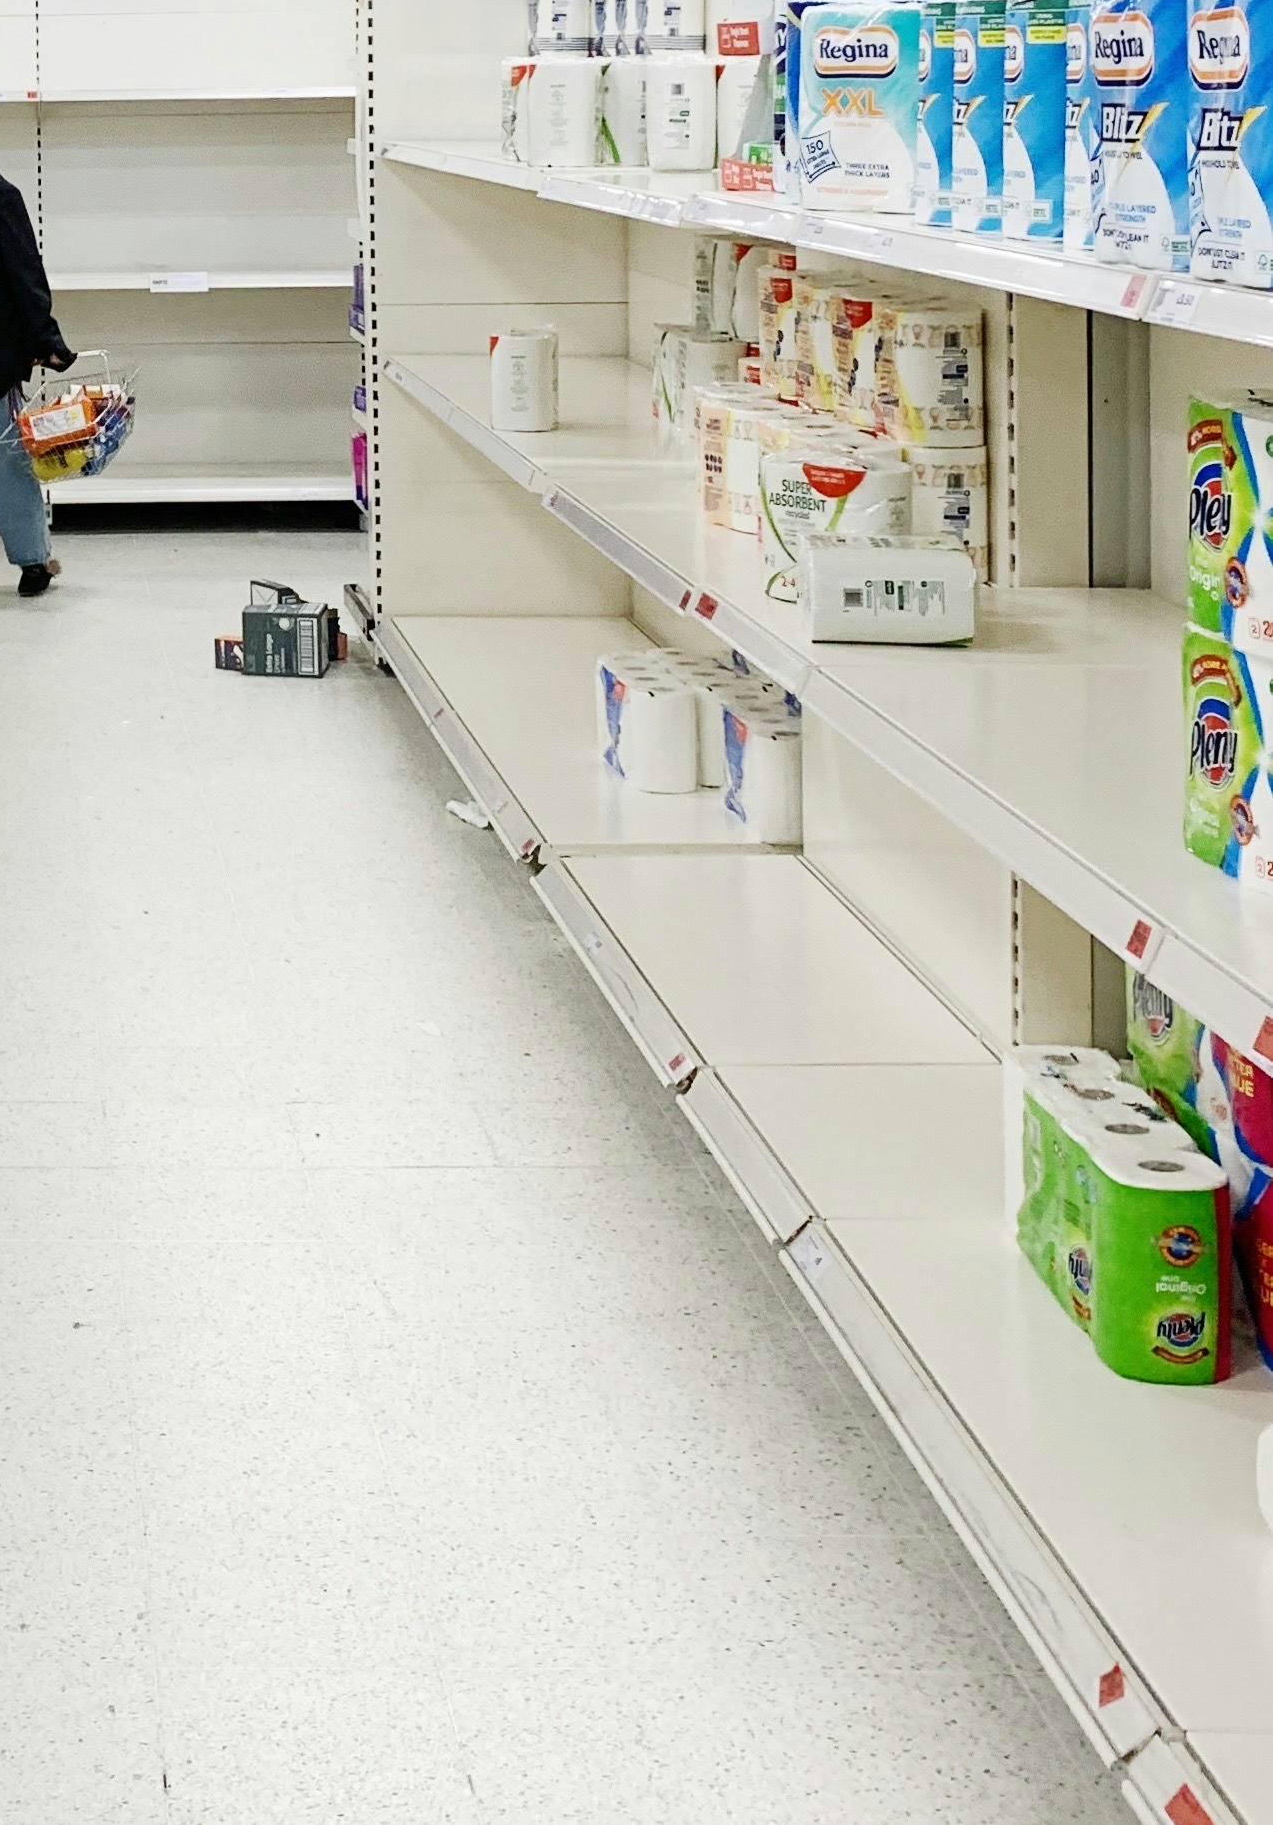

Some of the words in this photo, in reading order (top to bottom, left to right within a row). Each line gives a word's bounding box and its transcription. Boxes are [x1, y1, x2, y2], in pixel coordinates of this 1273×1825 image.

[820, 39, 889, 62] Regina
[1095, 30, 1144, 64] Regina
[822, 88, 885, 117] XXL
[806, 140, 823, 154] 150
[782, 479, 812, 495] SUPER
[768, 492, 827, 513] ABSORBENT
[1155, 1282, 1207, 1295] Original
[1157, 1311, 1206, 1339] Plenty
